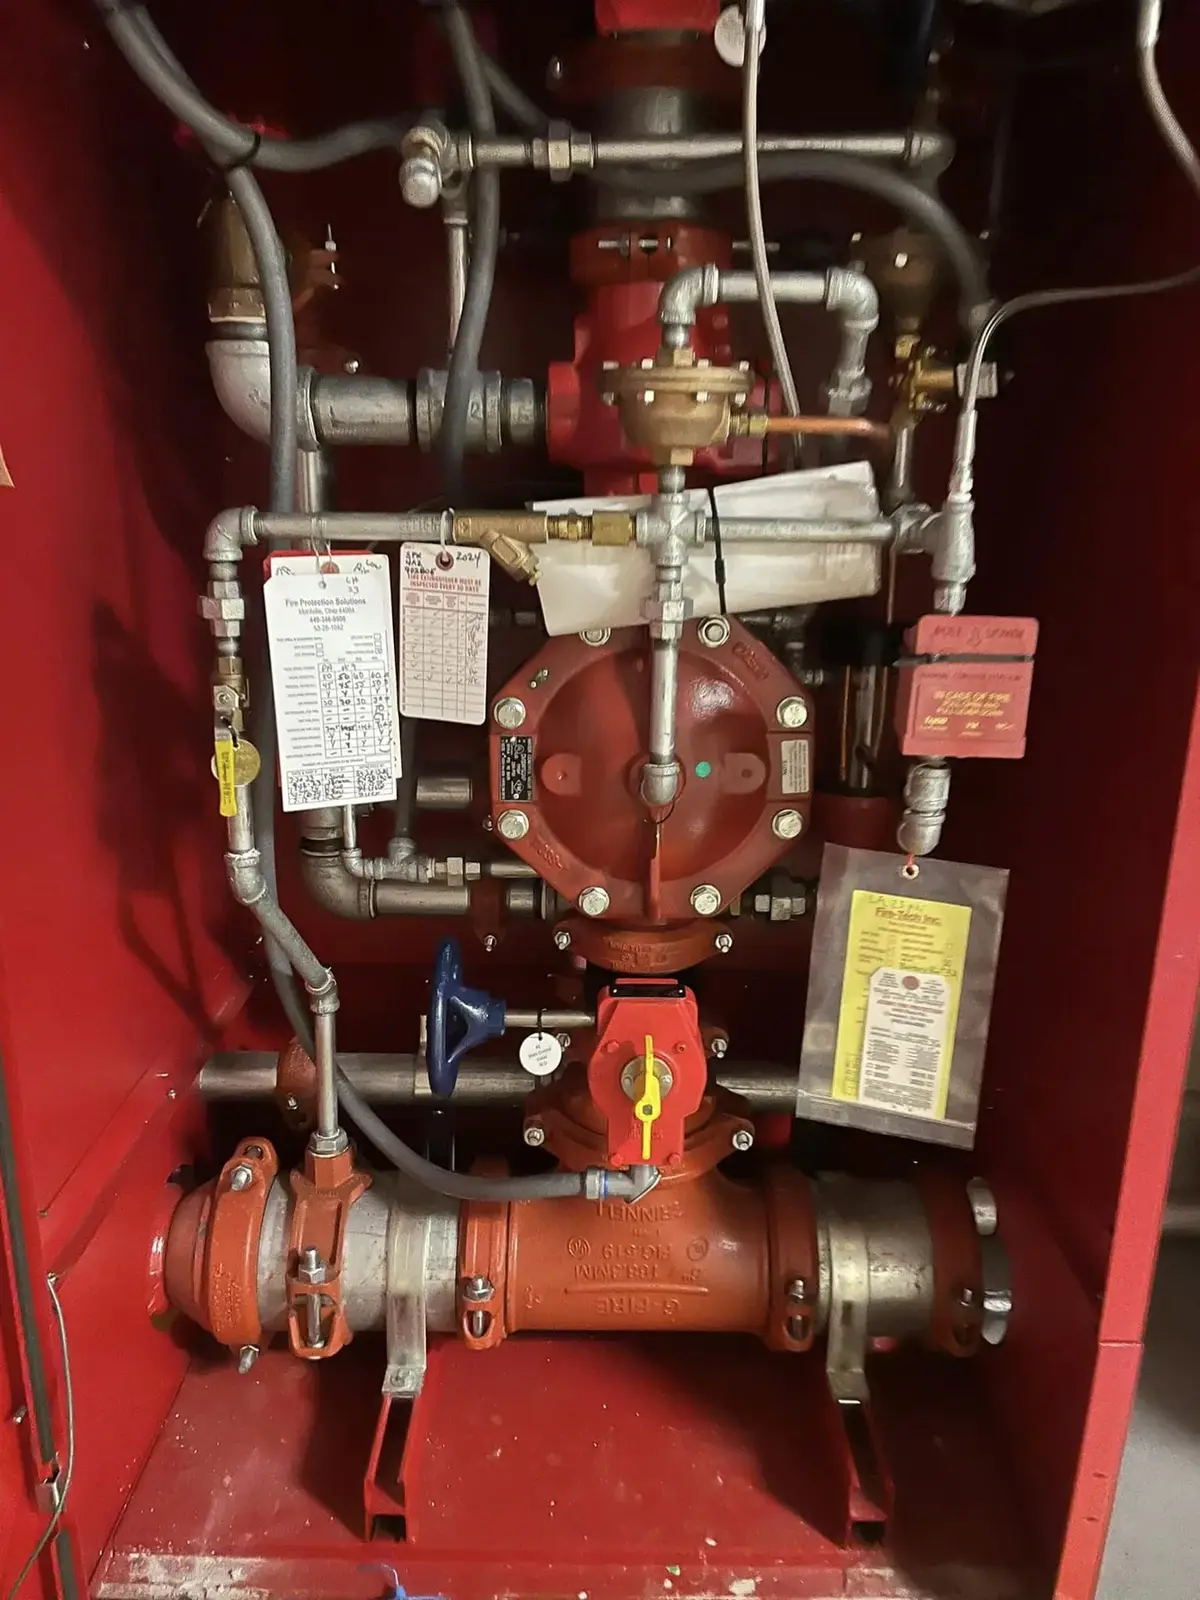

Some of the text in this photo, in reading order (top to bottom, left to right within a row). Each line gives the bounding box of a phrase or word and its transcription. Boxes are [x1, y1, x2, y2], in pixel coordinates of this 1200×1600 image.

[456, 551, 482, 569] 2024
[410, 580, 439, 589] INSPECTED
[439, 582, 456, 590] EVERY
[285, 597, 366, 607] Fire Protection Solutions
